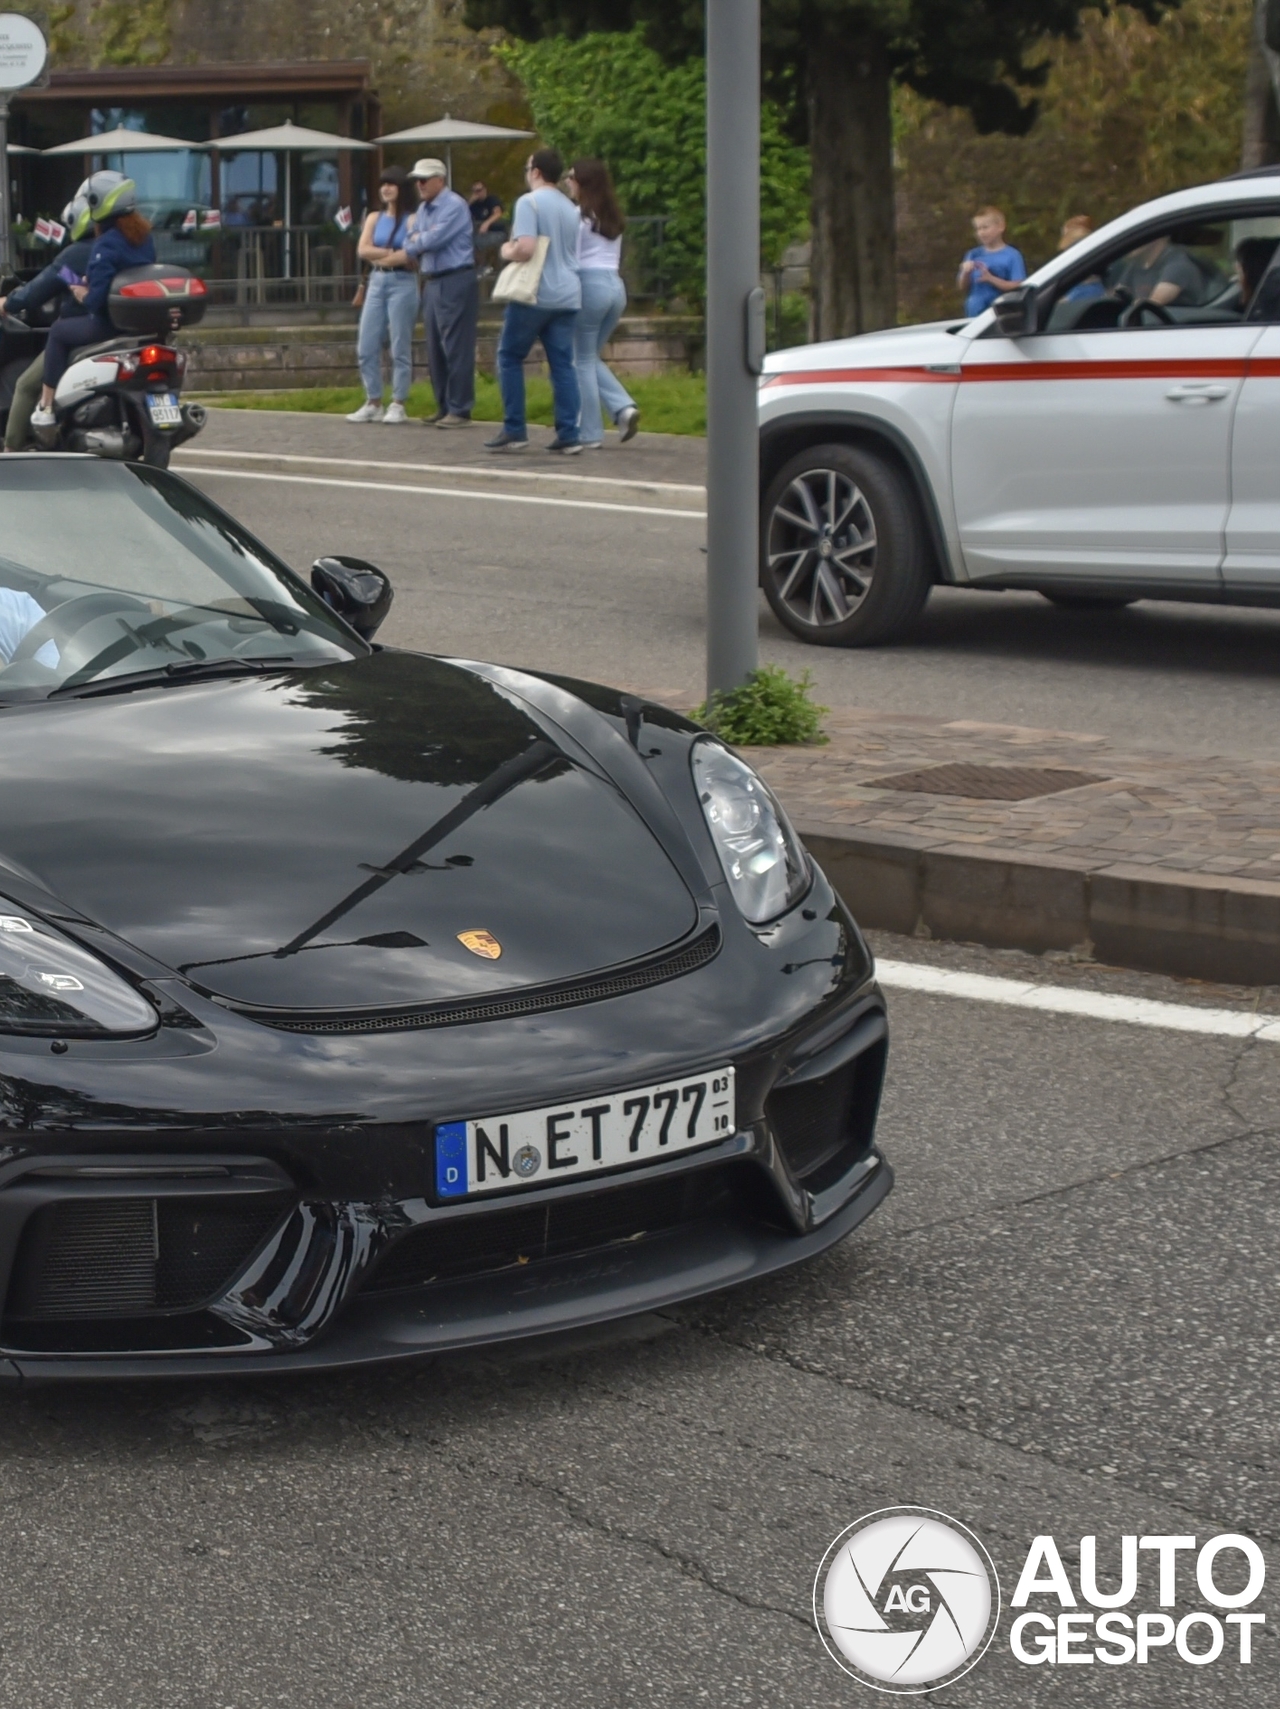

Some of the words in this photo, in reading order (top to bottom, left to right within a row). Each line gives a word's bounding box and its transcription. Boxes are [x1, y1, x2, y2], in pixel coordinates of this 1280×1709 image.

[712, 1076, 729, 1093] 03
[714, 1114, 729, 1131] 10
[446, 1167, 459, 1184] D
[476, 1123, 509, 1183] N
